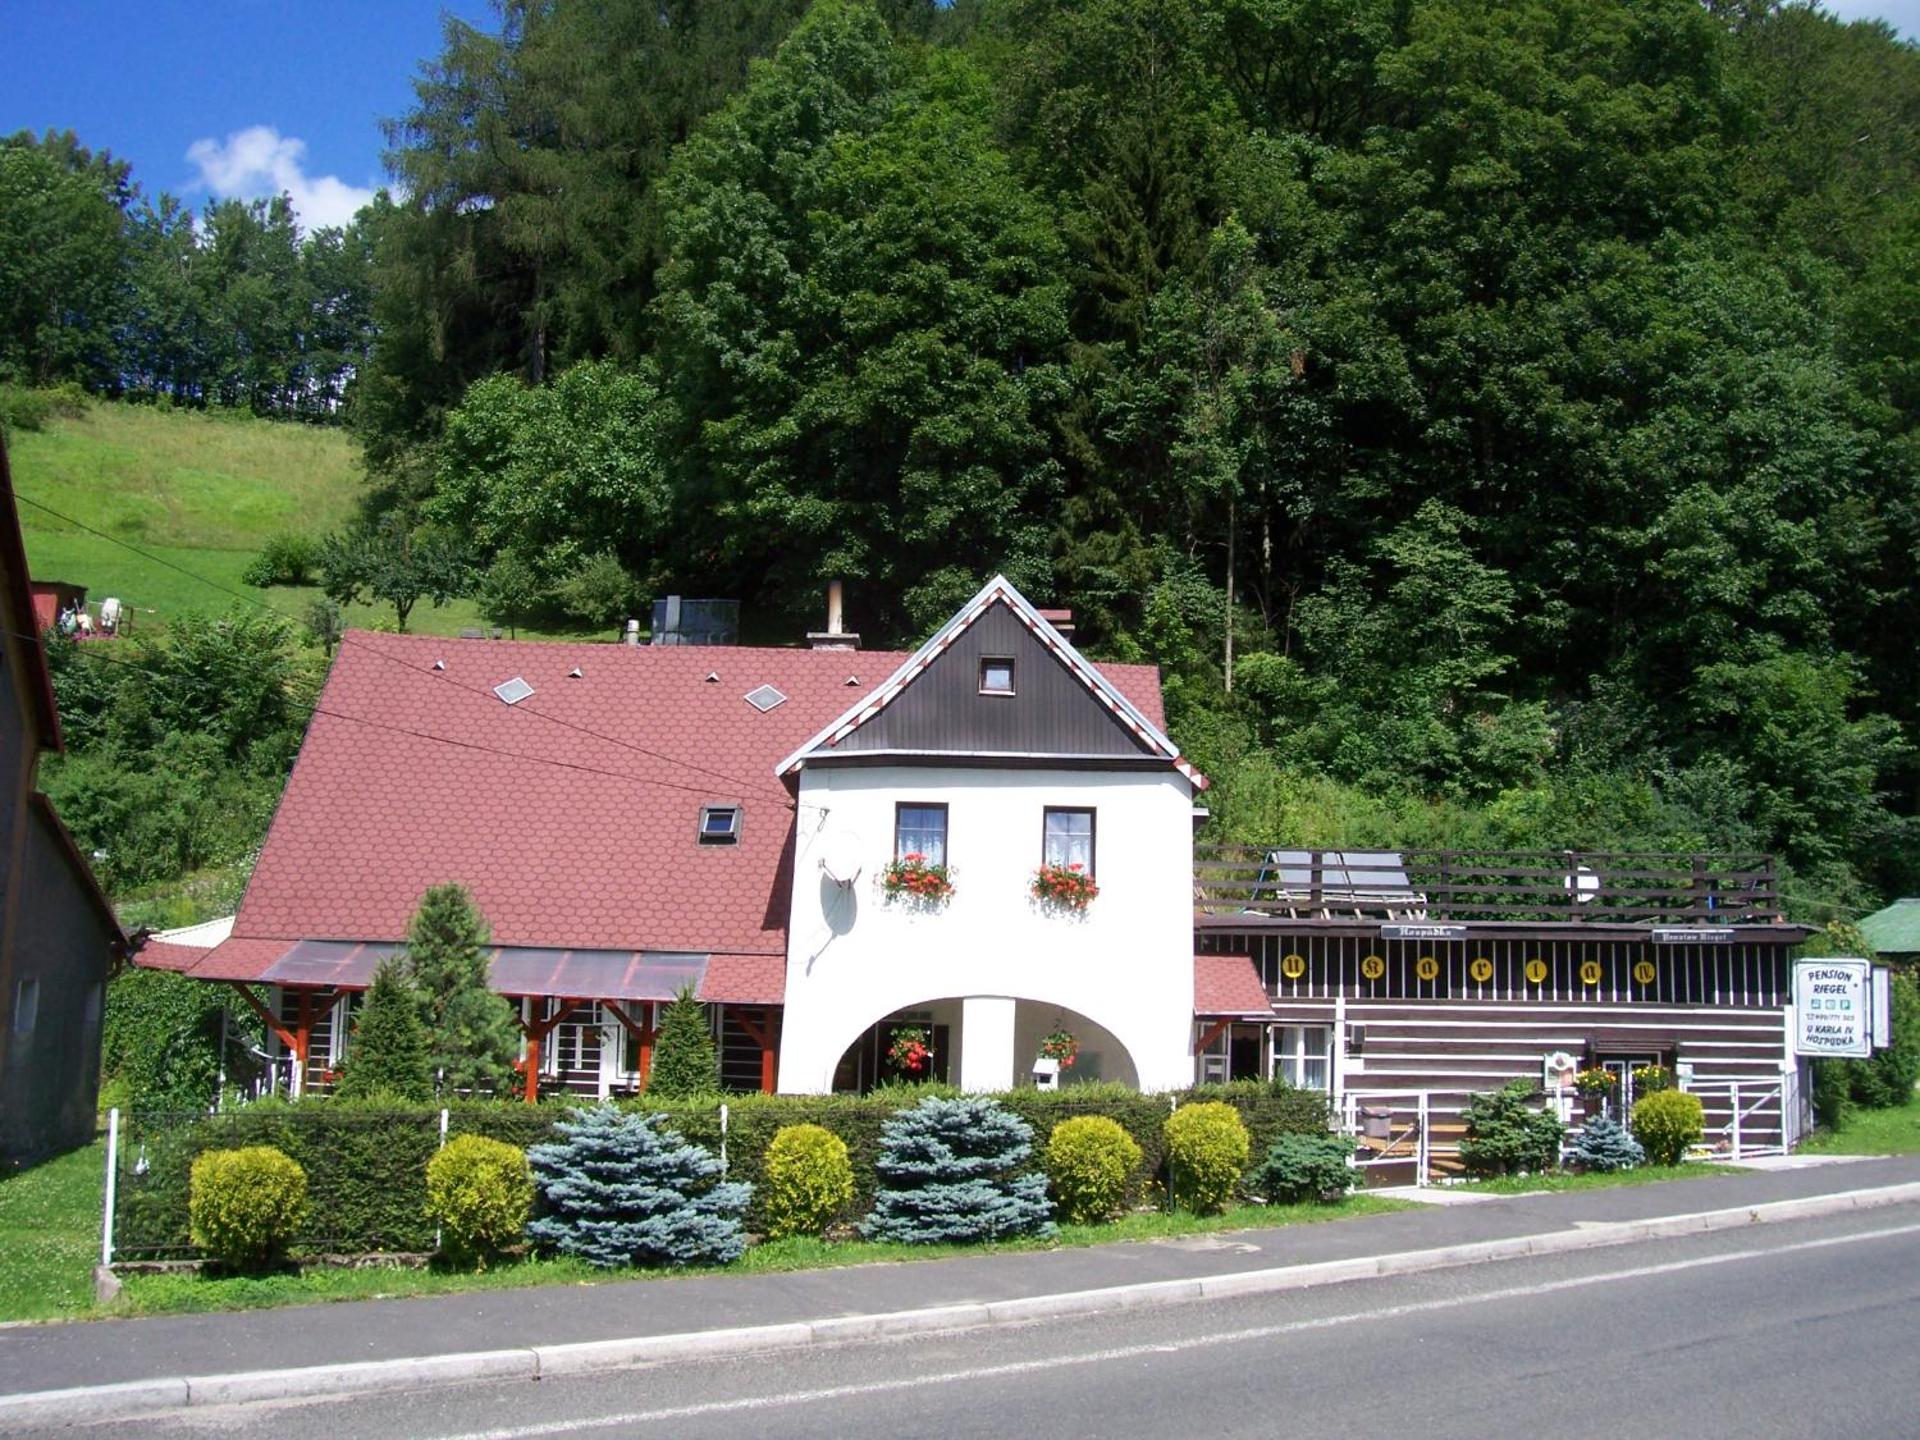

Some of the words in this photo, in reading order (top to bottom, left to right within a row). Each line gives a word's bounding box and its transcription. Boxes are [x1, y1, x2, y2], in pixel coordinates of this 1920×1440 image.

[1808, 969, 1852, 982] PENSION
[1813, 984, 1847, 994] RIEGEL
[1815, 1025, 1842, 1034] KARLA
